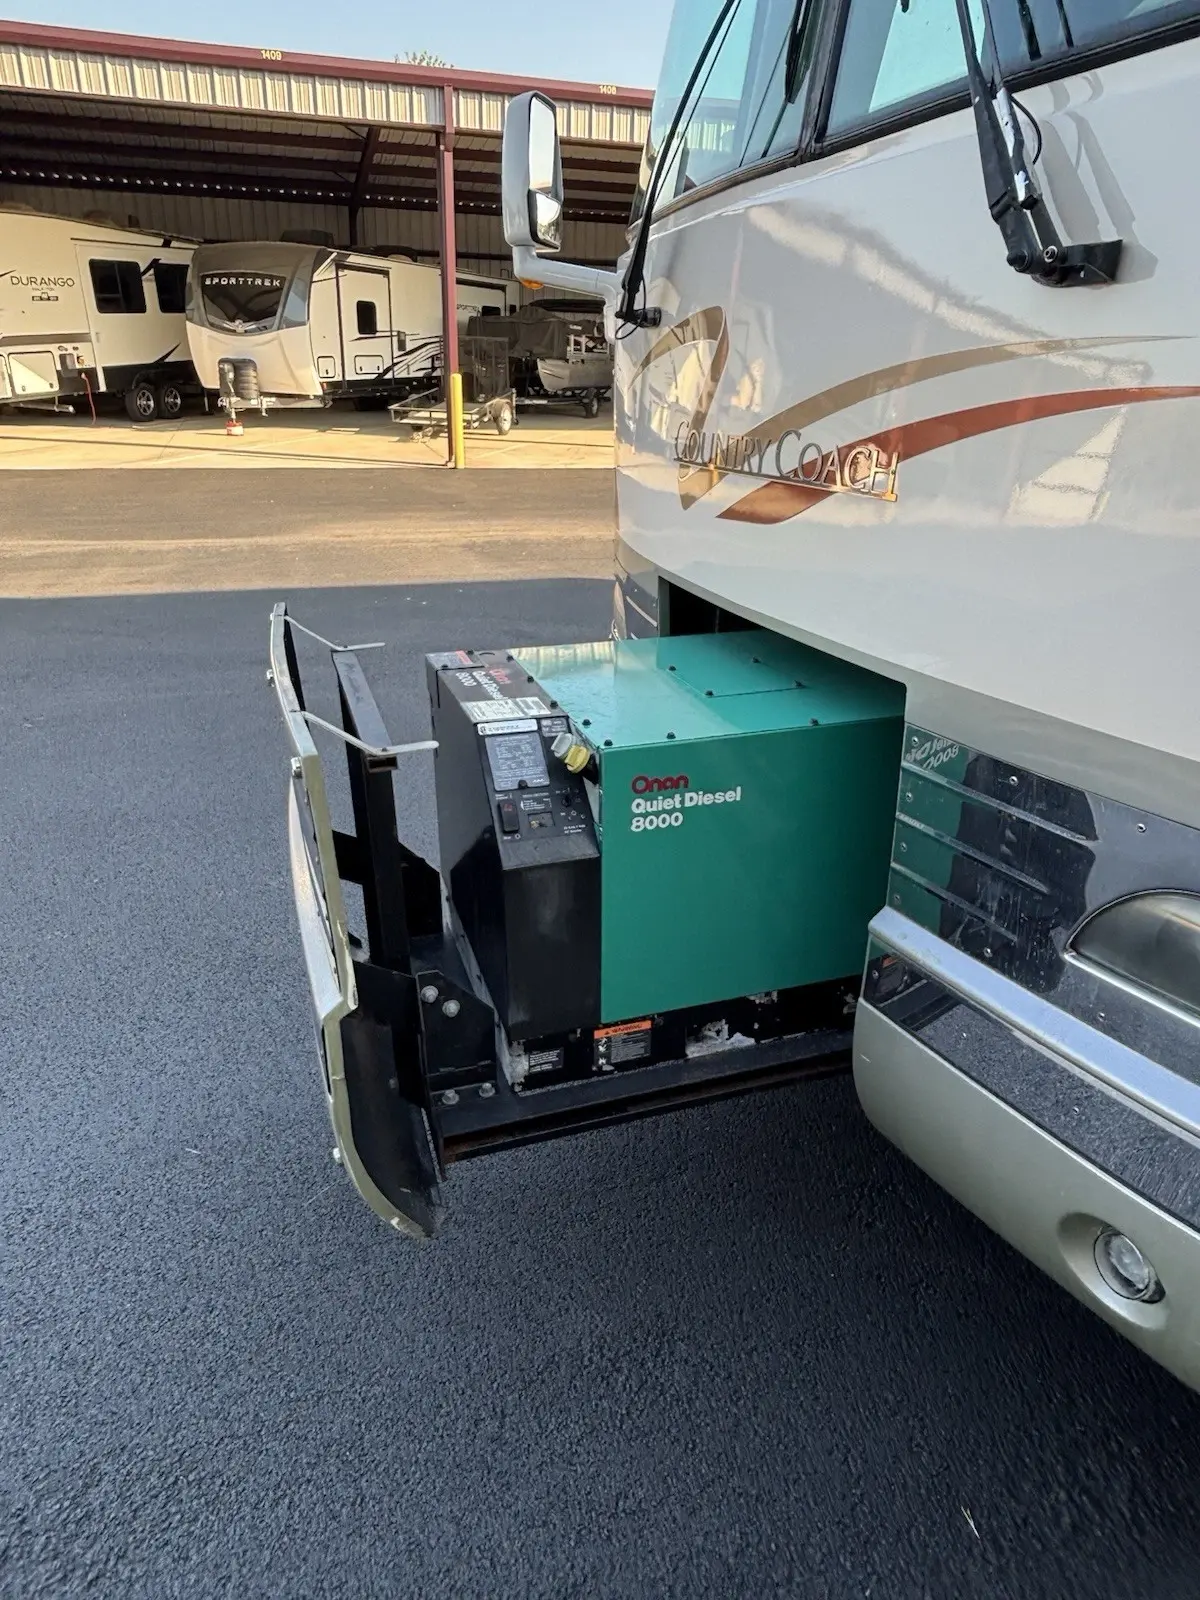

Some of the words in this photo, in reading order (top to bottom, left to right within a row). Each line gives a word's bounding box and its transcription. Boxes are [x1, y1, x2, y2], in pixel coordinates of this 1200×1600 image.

[260, 49, 282, 61] 1409
[10, 275, 75, 287] DURANGO
[205, 277, 281, 287] SPORTTREK
[631, 774, 689, 794] Onan
[631, 793, 682, 814] Quiet
[684, 785, 742, 807] Diesel
[630, 811, 684, 832] 8000
